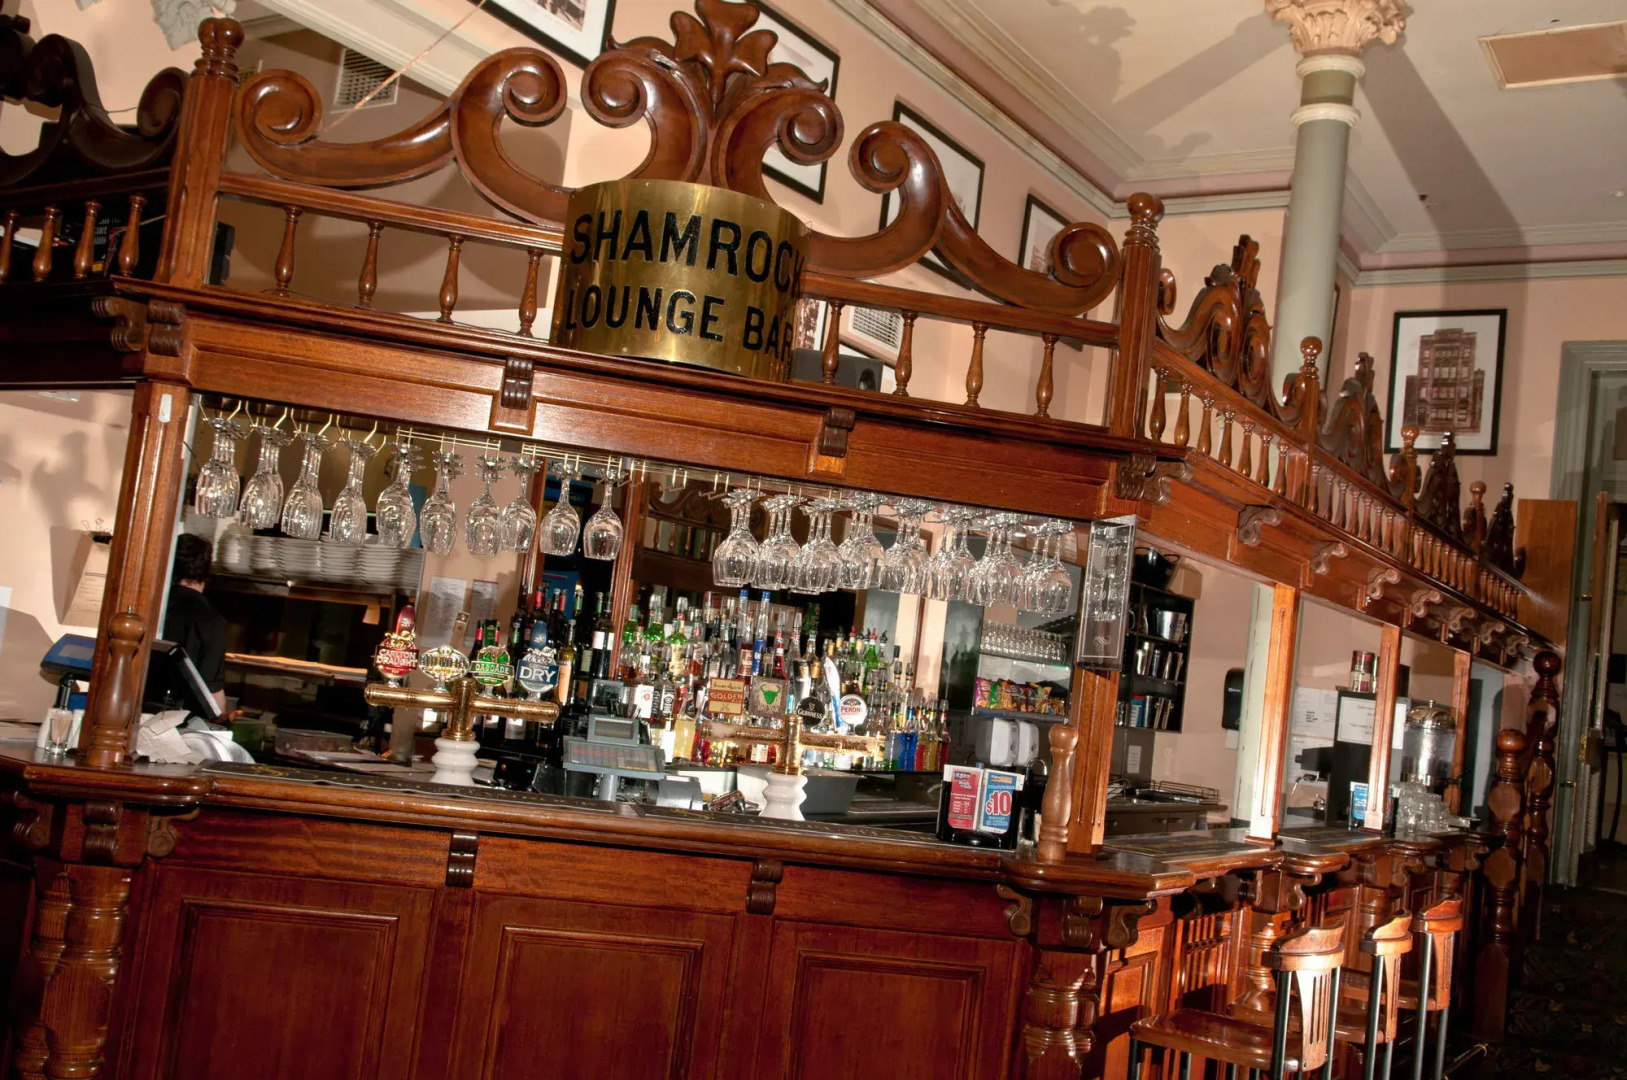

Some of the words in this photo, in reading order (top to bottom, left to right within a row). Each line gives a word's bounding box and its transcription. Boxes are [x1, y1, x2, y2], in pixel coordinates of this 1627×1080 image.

[570, 209, 805, 299] SHAMROCK
[565, 285, 726, 343] LOUNGE
[742, 305, 794, 364] BAR
[378, 648, 417, 660] CARLTON
[375, 655, 418, 667] DRAUGHT
[475, 662, 510, 674] CASCADE
[519, 666, 556, 682] DRY
[710, 692, 743, 700] GOLDEN
[797, 708, 823, 719] GUINNESS
[986, 791, 1013, 816] $10
